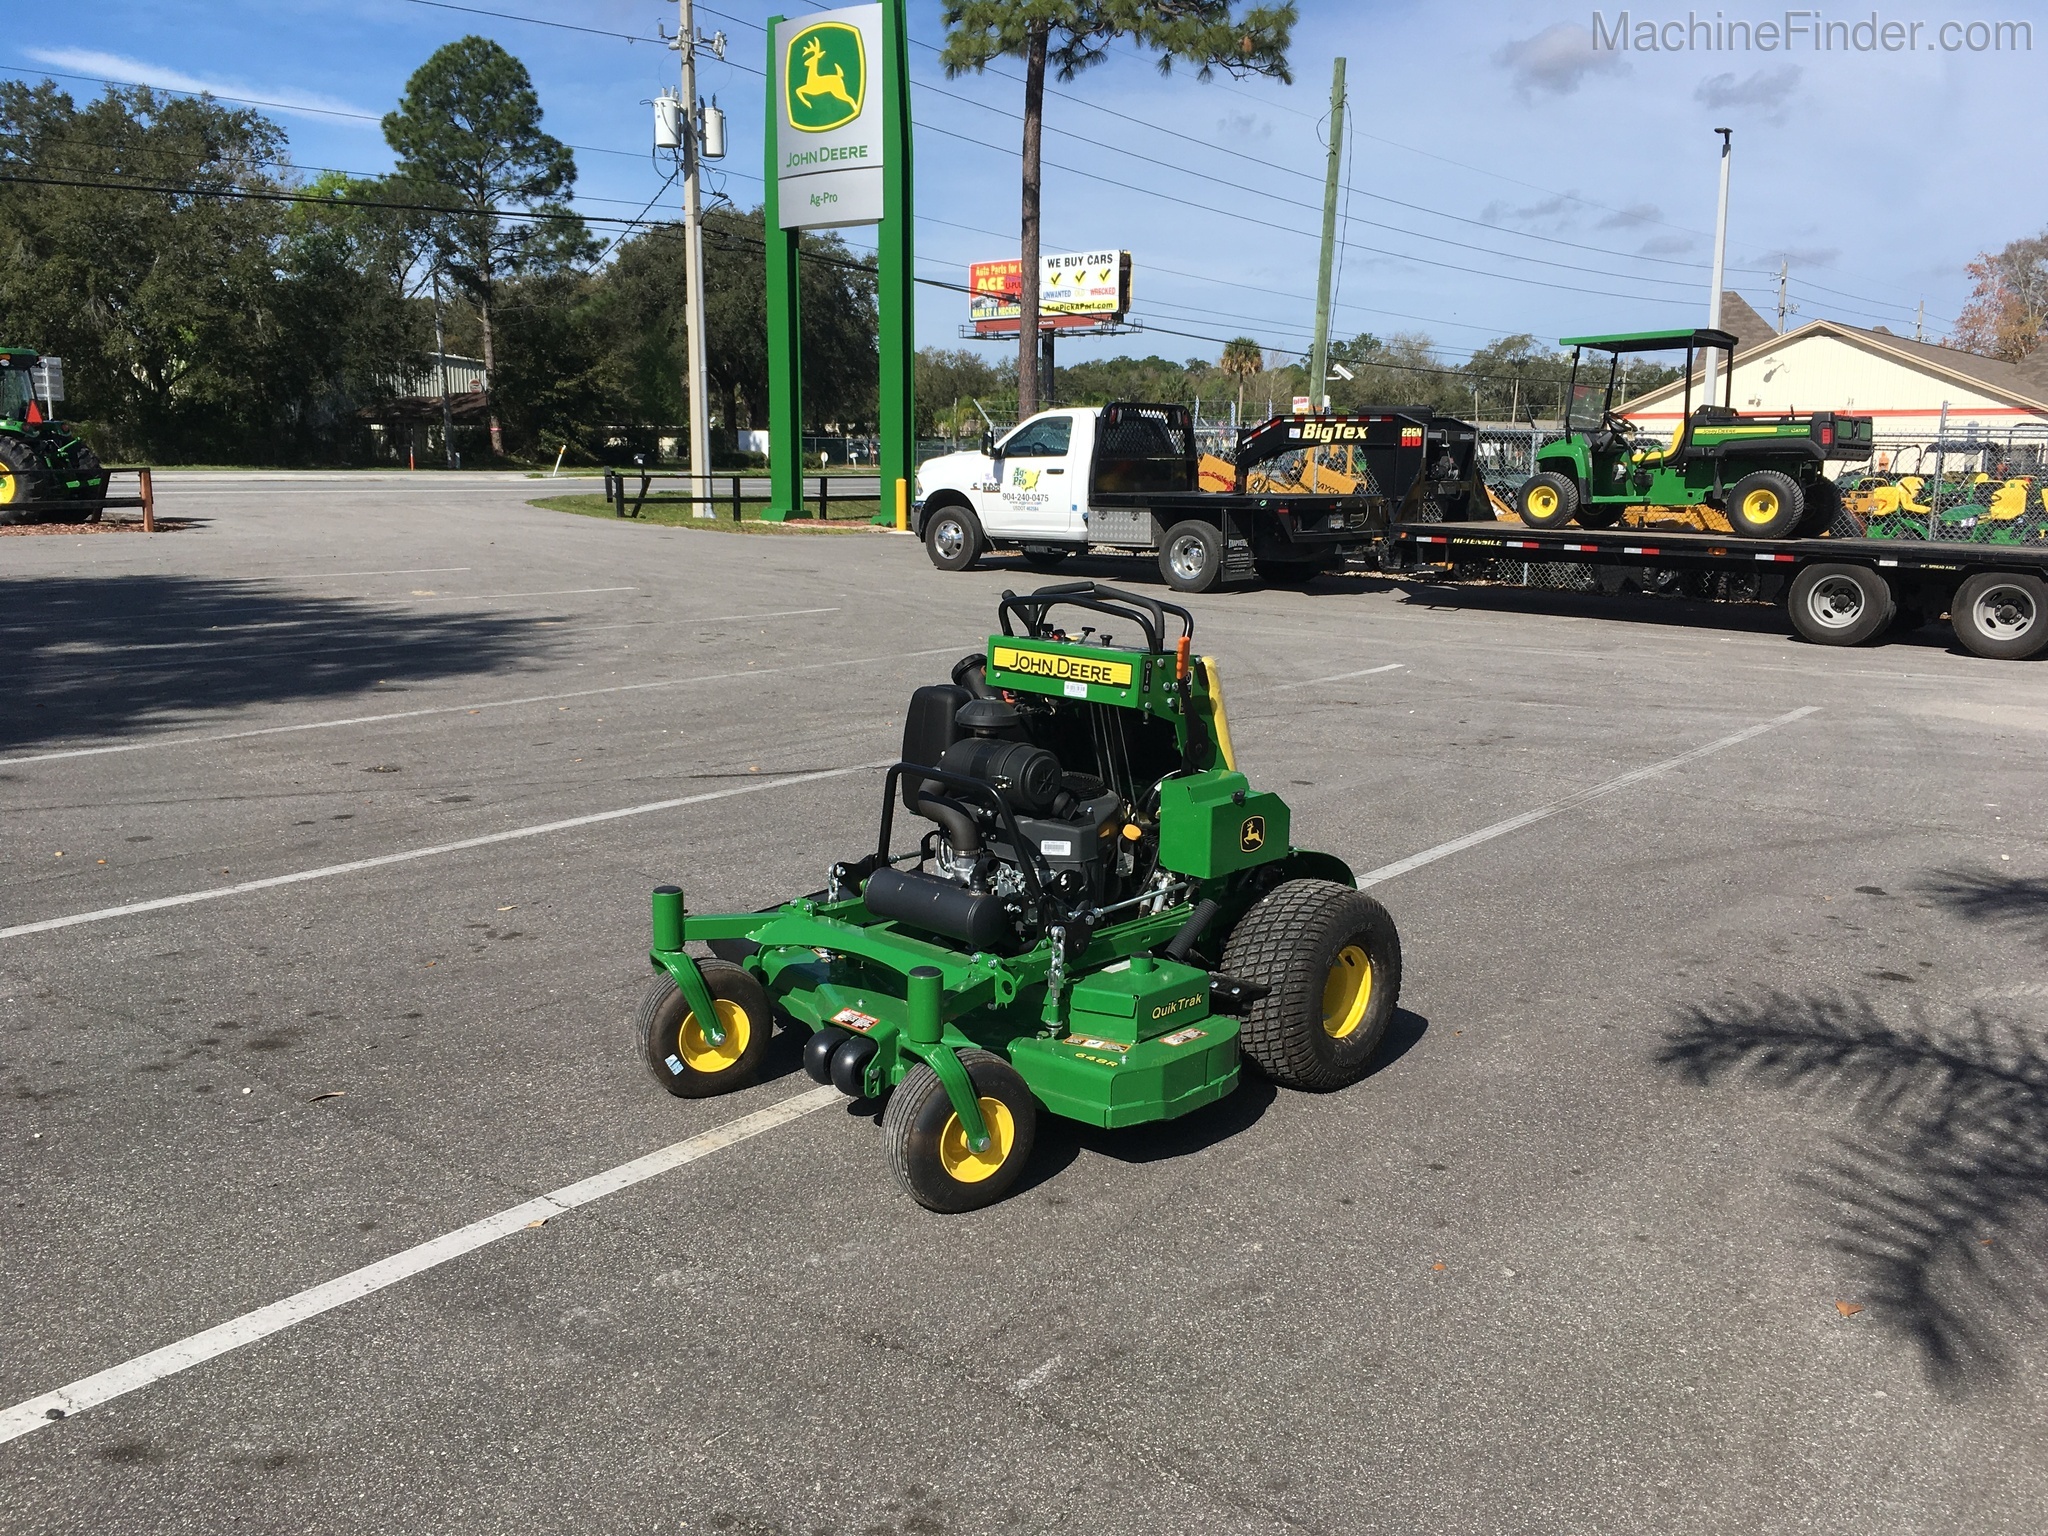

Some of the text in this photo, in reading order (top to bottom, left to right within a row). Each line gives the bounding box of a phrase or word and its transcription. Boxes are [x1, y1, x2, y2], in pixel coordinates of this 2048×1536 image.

[786, 145, 868, 168] JOHN DEERE
[809, 192, 838, 207] Ag-Pro
[1047, 254, 1113, 269] WE BUY CARS
[975, 266, 990, 276] Auto
[991, 264, 1007, 275] Parts
[1008, 263, 1017, 273] for
[976, 276, 1005, 291] ACE
[1005, 281, 1022, 289] U-PUL
[1043, 289, 1072, 299] UNWANTED
[1090, 287, 1116, 296] WRECKED
[985, 307, 993, 317] ST
[1302, 423, 1369, 443] BigTex
[1401, 436, 1422, 447] HD
[1013, 467, 1027, 478] Ag-
[1012, 477, 1027, 486] Pro
[1002, 492, 1049, 502] 904-240-0475
[1452, 537, 1503, 547] HI-TENSILE
[1010, 652, 1112, 682] JOHN DEERE
[1074, 1052, 1119, 1068] 648R
